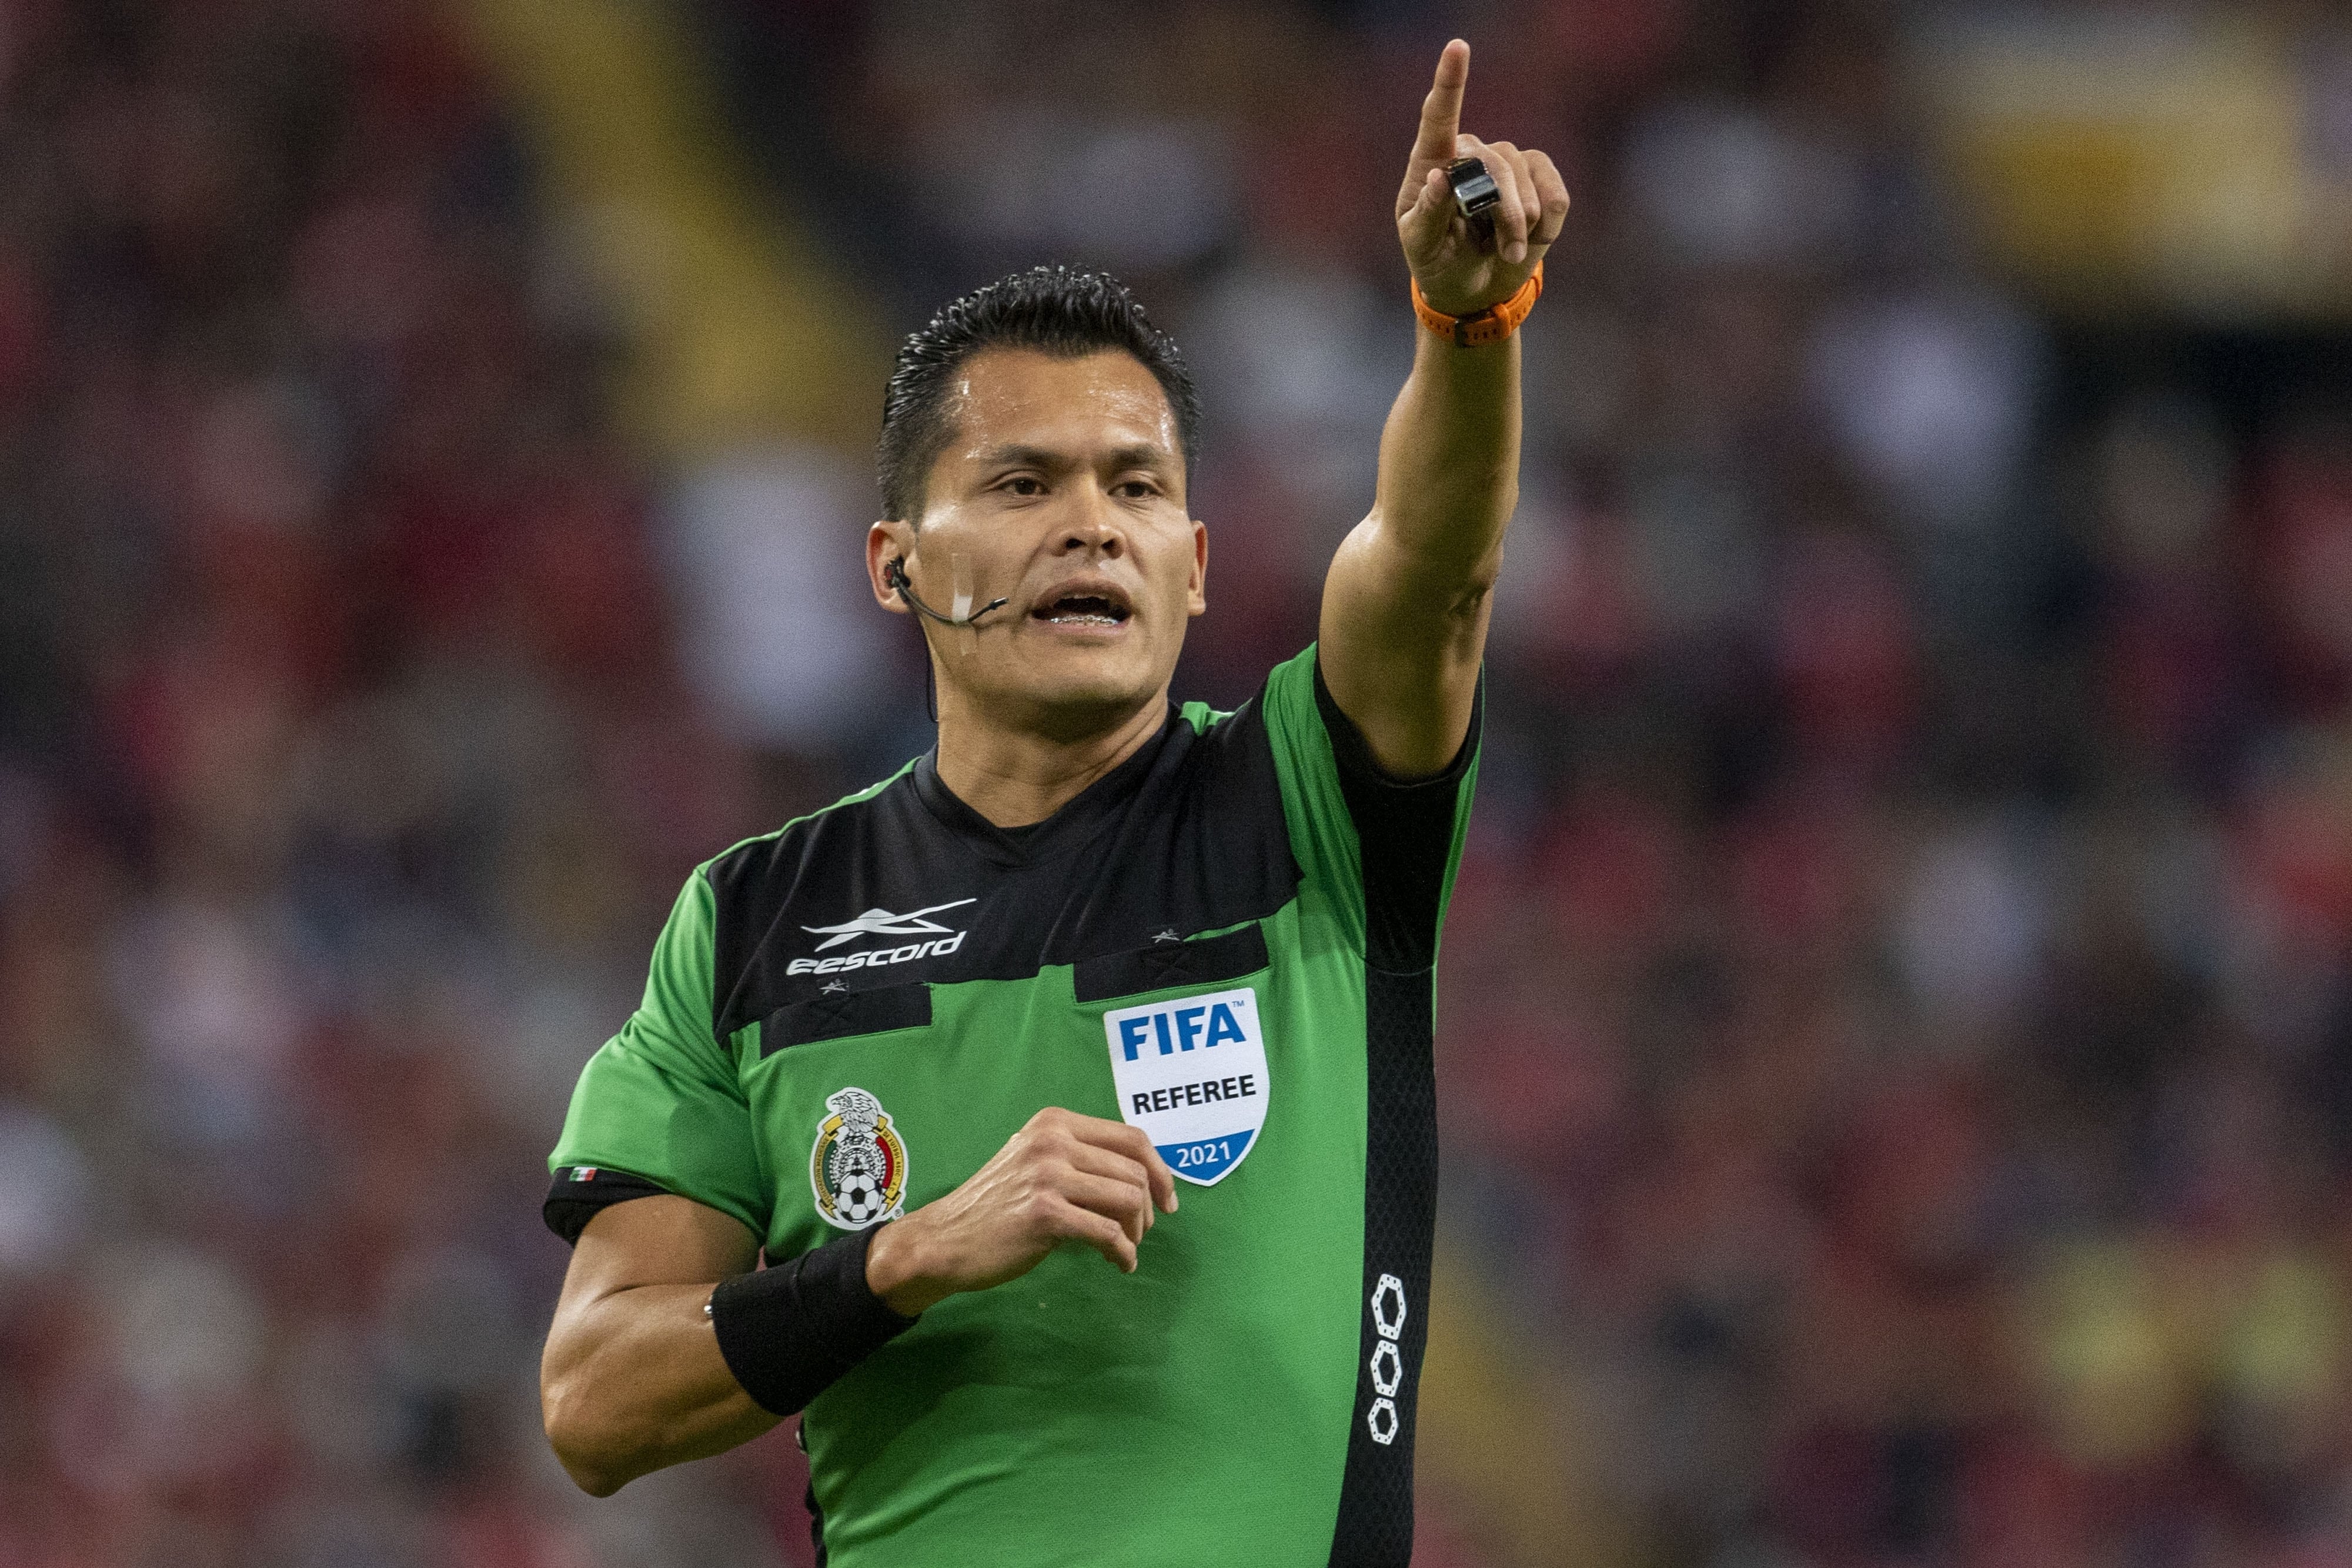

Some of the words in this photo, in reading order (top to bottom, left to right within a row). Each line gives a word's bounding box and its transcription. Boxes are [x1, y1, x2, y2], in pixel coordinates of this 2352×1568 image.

[1118, 1002, 1247, 1062] FIFA
[1131, 1074, 1257, 1115] REFEREE
[1177, 1141, 1231, 1168] 2021
